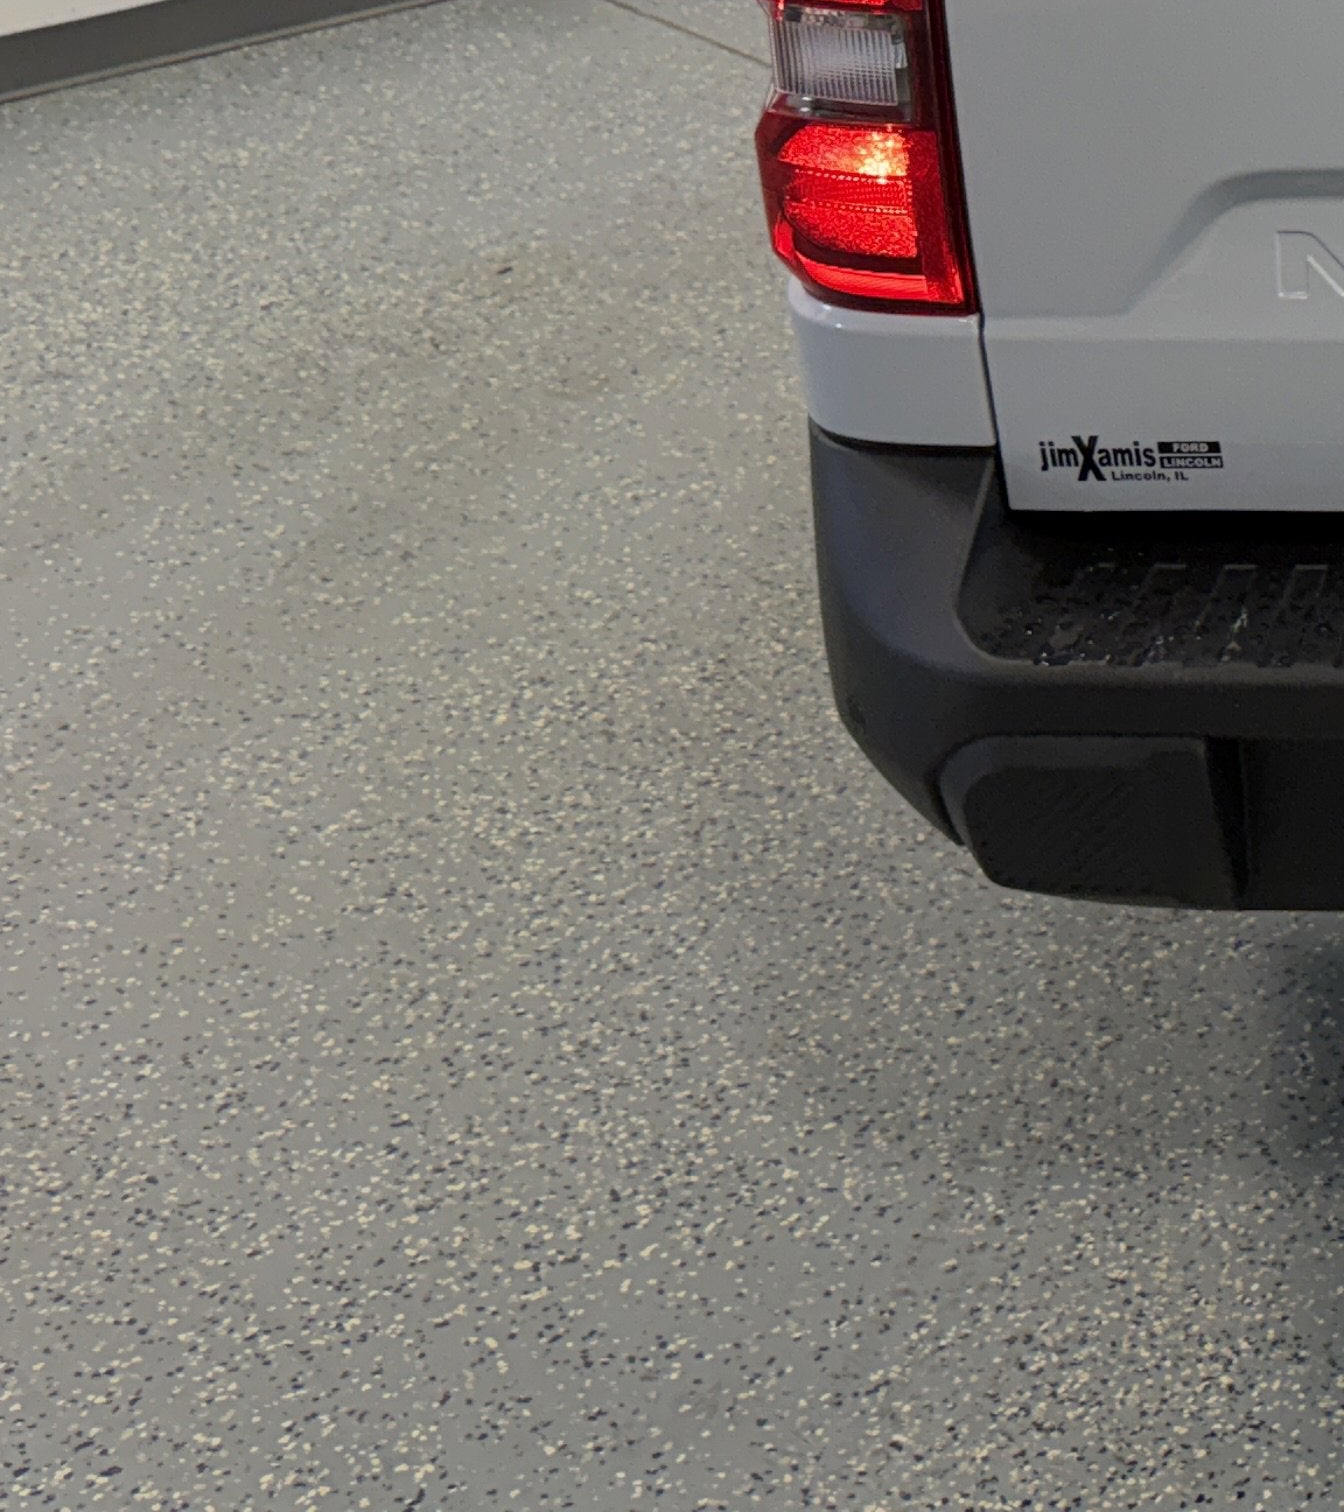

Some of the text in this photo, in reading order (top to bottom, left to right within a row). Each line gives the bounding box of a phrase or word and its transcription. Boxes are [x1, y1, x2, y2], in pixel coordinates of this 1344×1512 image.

[1172, 442, 1210, 453] FORD
[1162, 456, 1222, 468] LINCOLN
[1111, 470, 1189, 482] Lincoln, IL
